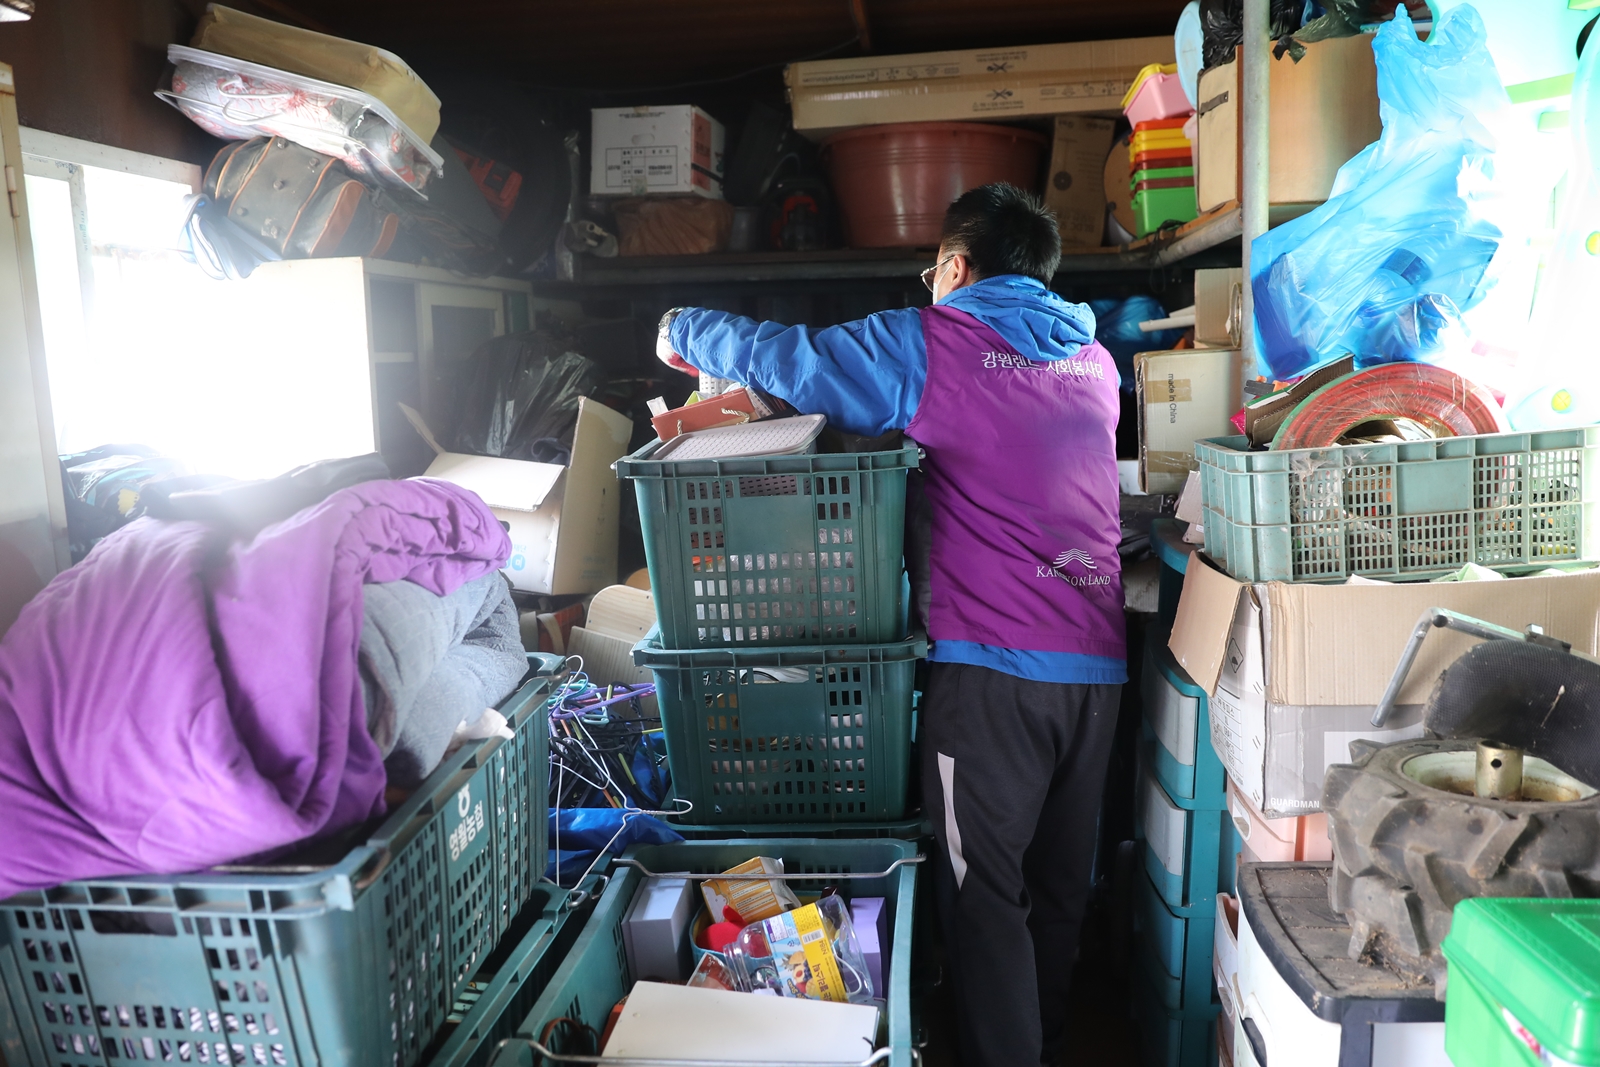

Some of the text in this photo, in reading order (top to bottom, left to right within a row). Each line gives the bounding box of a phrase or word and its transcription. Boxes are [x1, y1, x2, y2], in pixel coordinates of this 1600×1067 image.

[1169, 402, 1178, 424] China
[1035, 565, 1087, 587] KANON
[1270, 797, 1320, 808] GUARDMAN
[449, 800, 485, 862] 영월농협
